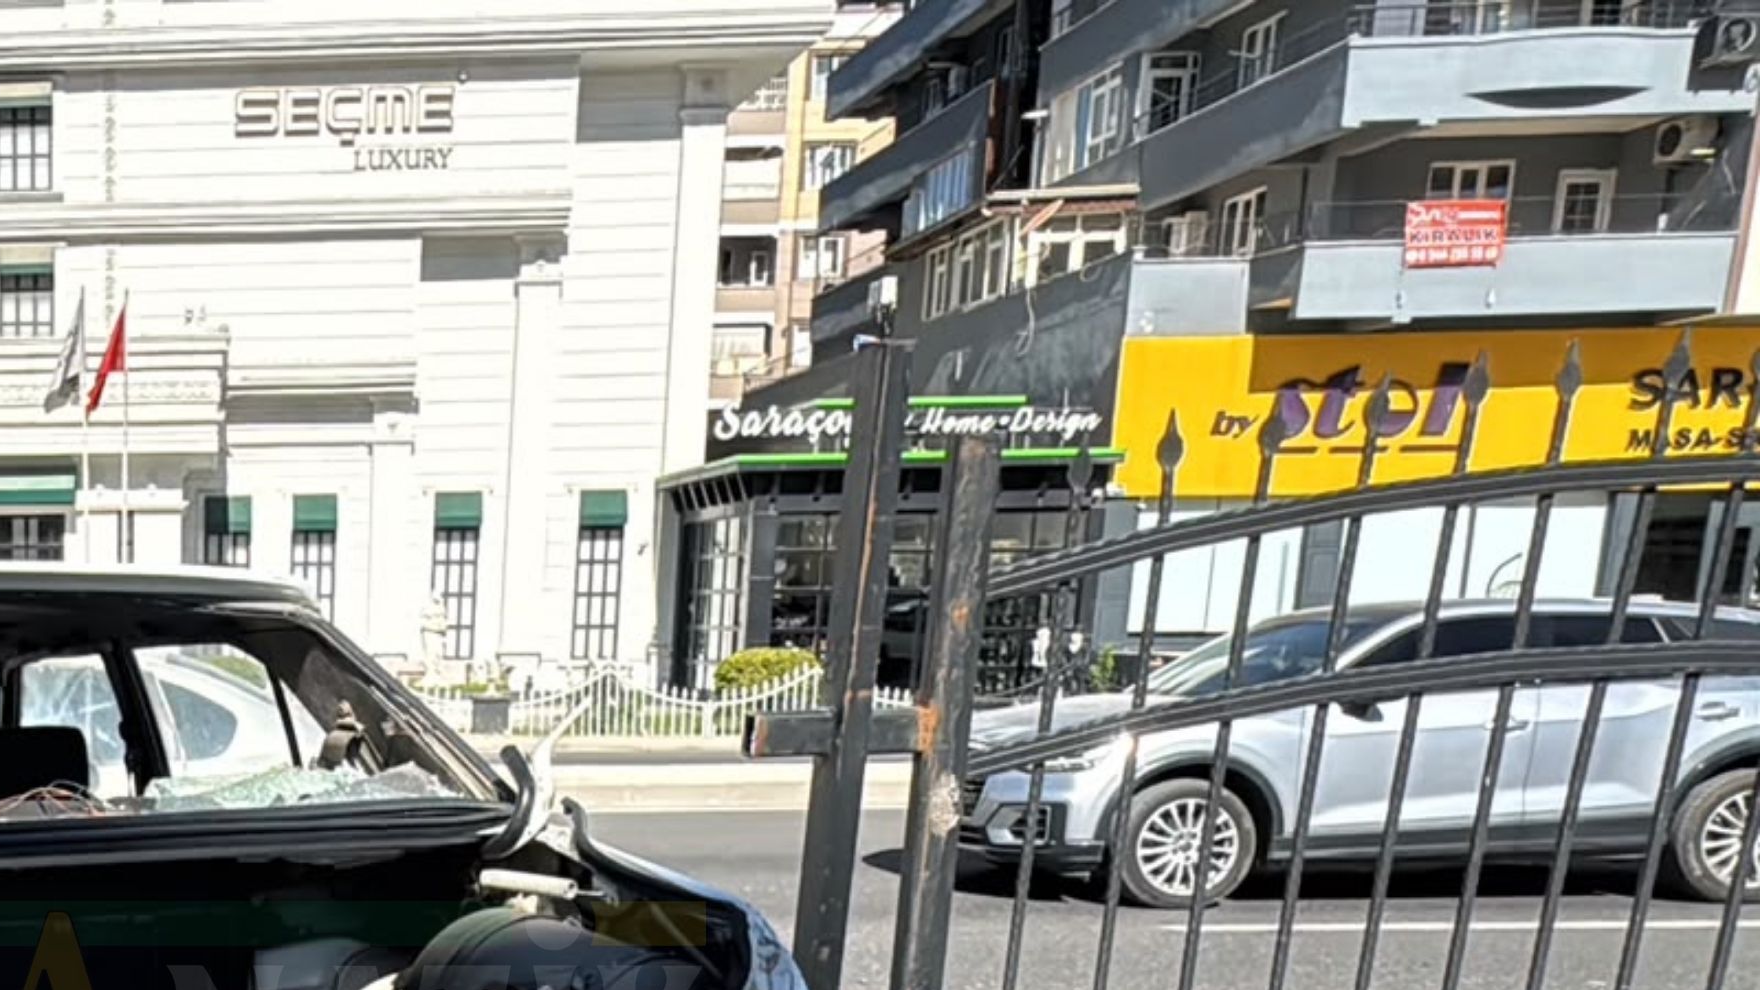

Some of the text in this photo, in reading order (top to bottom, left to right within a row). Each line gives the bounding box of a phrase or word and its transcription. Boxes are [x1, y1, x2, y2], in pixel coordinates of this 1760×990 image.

[234, 84, 455, 148] SEÇME
[352, 146, 454, 171] LUXURY
[1210, 410, 1259, 439] by
